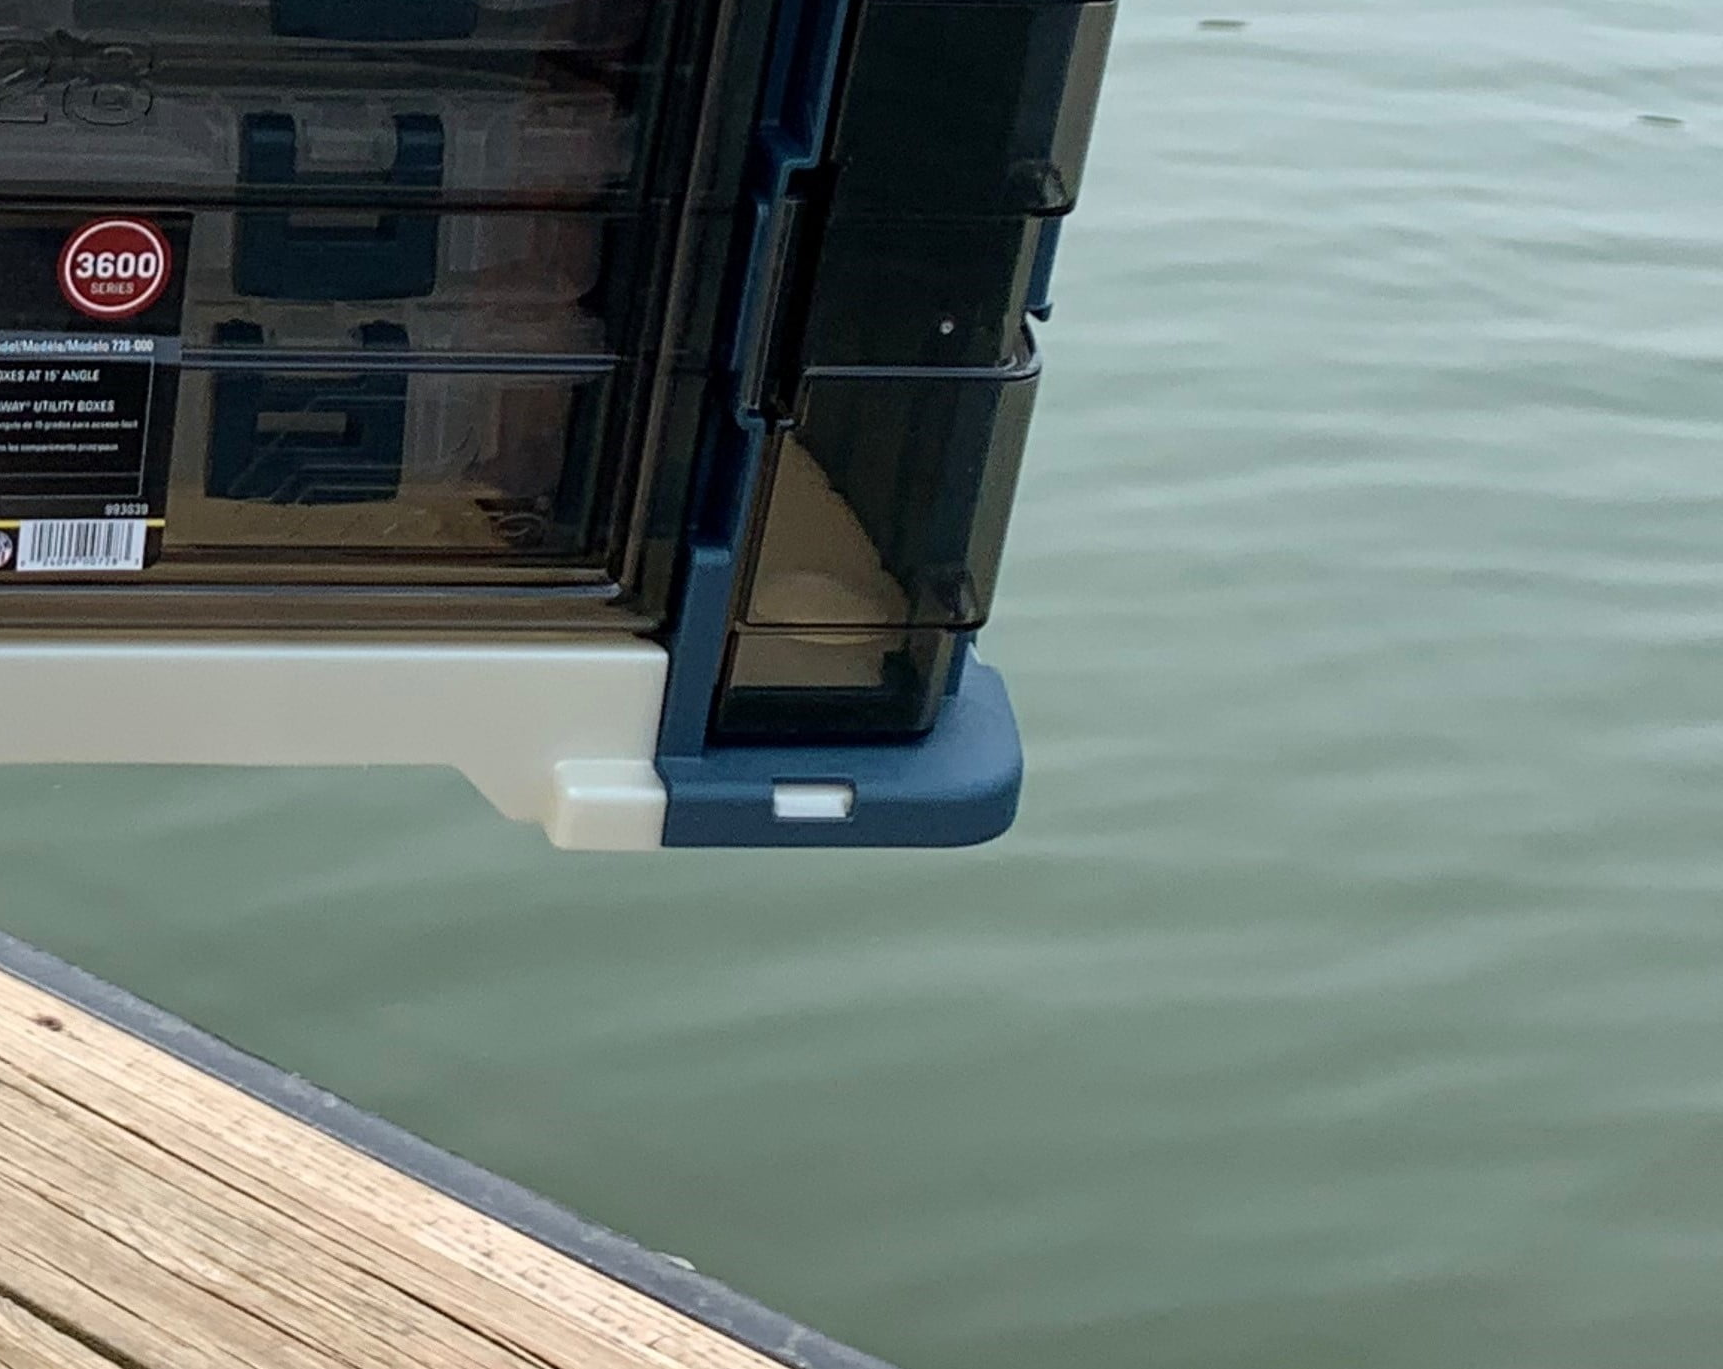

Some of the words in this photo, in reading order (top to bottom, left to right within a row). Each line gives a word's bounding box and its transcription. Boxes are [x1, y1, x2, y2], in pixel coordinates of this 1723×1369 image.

[76, 252, 157, 279] 3600
[90, 282, 135, 295] SERIES
[112, 339, 154, 352] 728-000
[27, 370, 42, 381] AT
[62, 369, 101, 381] ANGLE
[33, 400, 75, 412] UTILITY
[77, 400, 115, 412] BOXES
